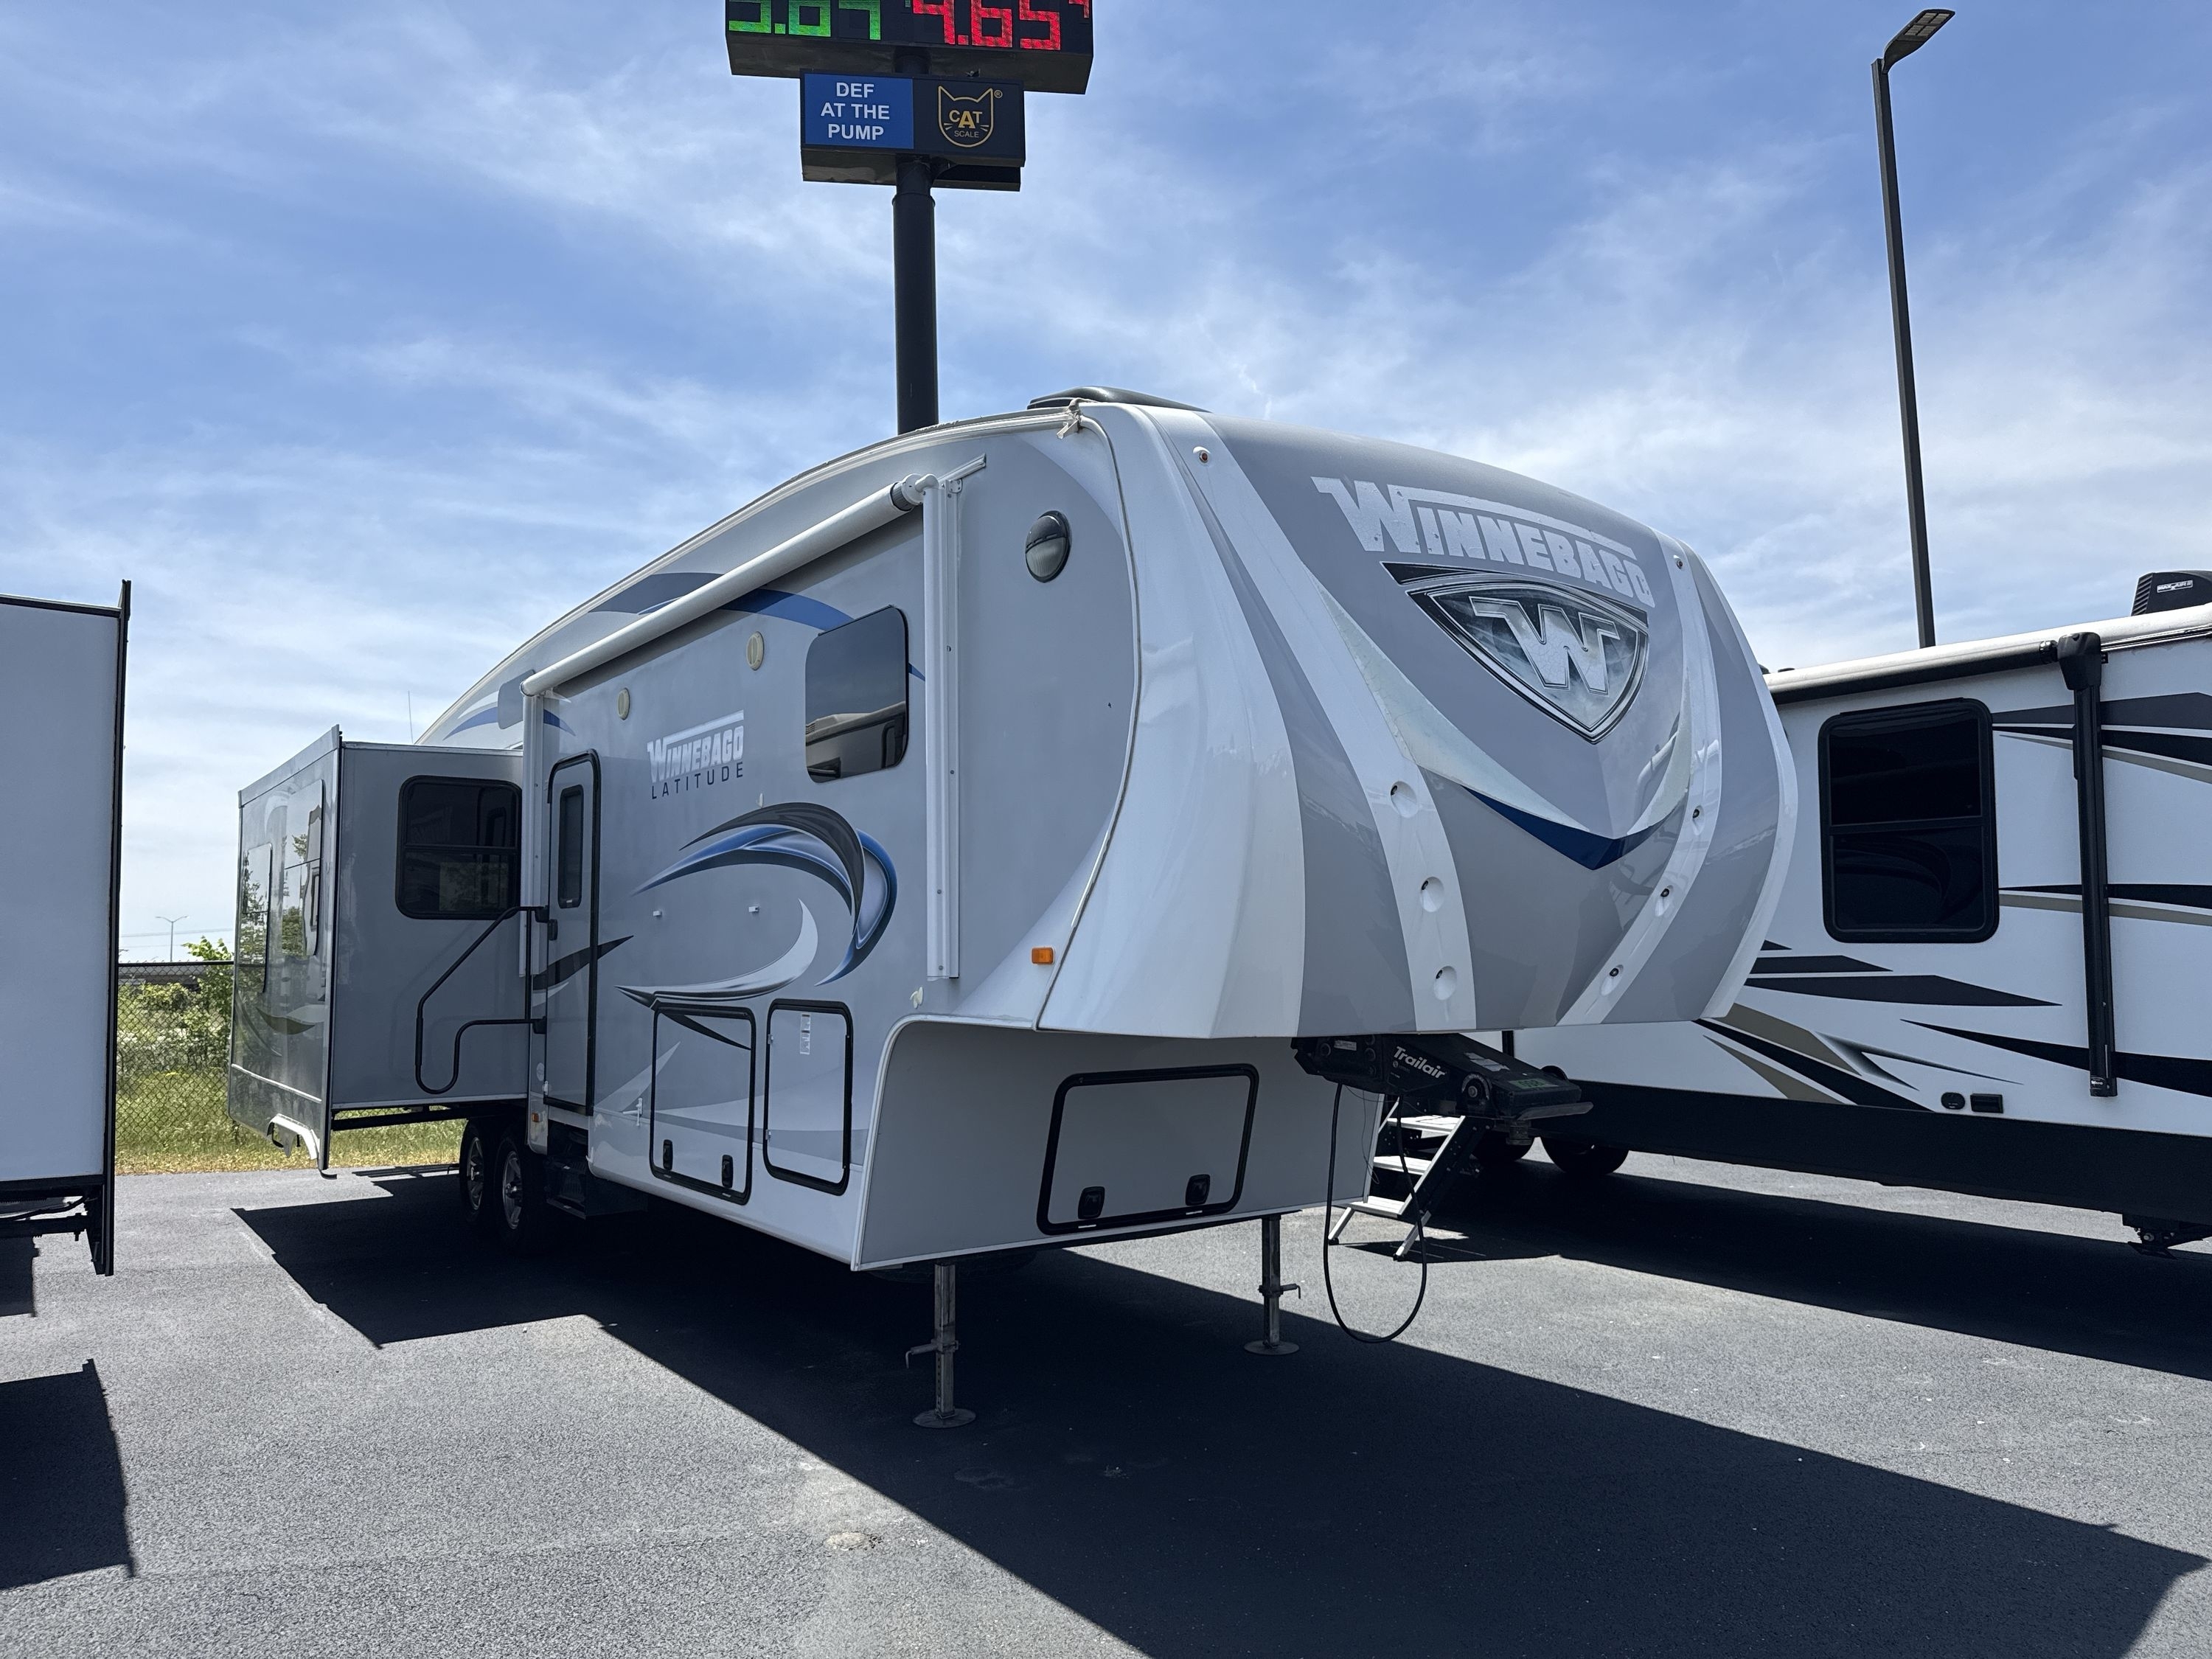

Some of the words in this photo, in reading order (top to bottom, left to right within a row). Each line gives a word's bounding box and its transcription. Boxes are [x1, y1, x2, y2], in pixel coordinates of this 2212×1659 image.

[836, 82, 874, 98] DEF
[821, 102, 846, 117] AT
[851, 104, 890, 120] THE
[949, 110, 983, 129] CAT
[828, 123, 884, 140] PUMP
[1311, 476, 1655, 608] WINNEBAGO
[647, 710, 744, 783] WINNEBAGO
[652, 762, 743, 799] LATITUDE
[1394, 1046, 1446, 1078] Trailair
